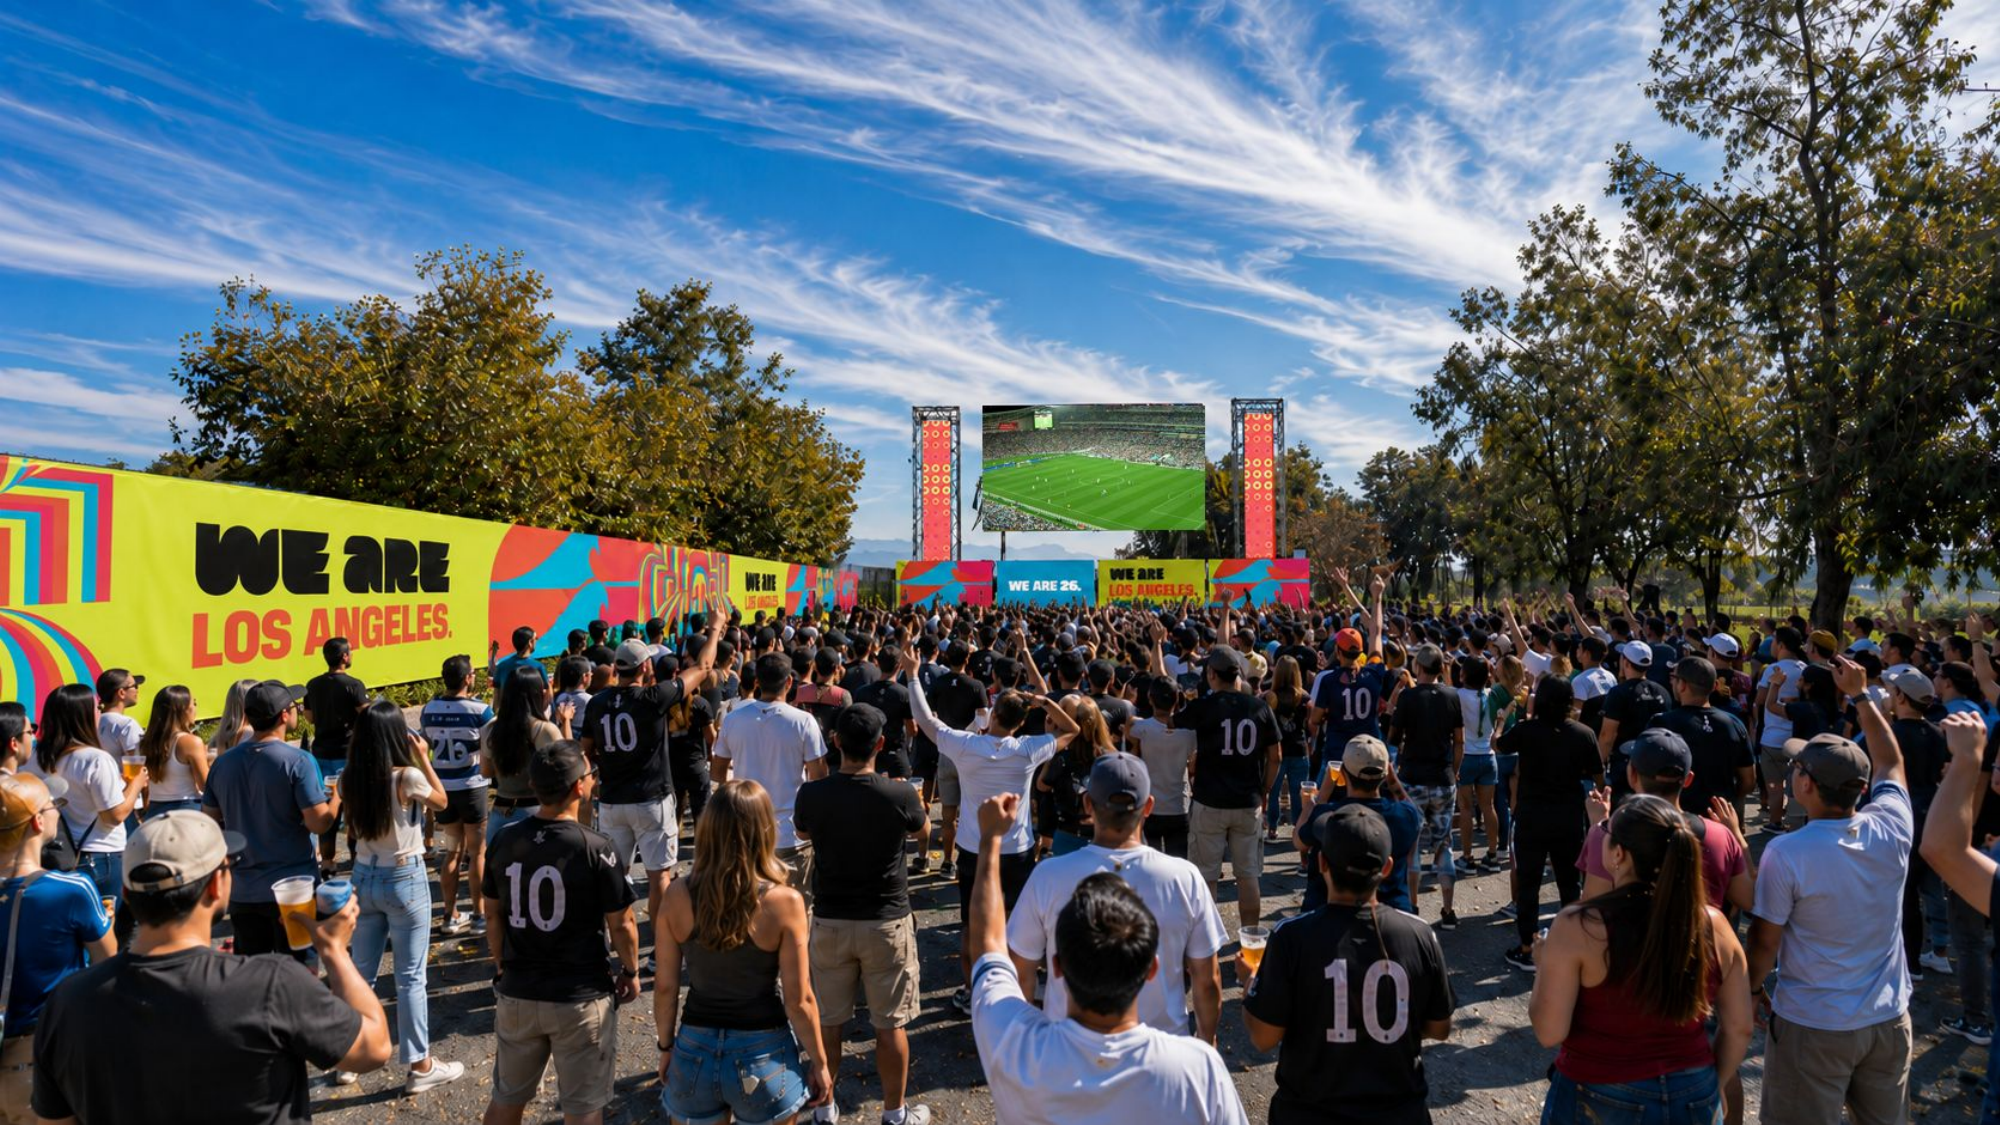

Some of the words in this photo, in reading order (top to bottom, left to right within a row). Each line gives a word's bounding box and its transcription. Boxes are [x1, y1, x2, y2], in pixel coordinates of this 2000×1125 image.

[195, 522, 330, 596] WE
[1110, 568, 1134, 580] WE
[1008, 580, 1030, 591] WE
[1032, 580, 1058, 591] ARE
[1060, 580, 1082, 591] 26.
[1109, 584, 1133, 597] LOS
[192, 609, 292, 669] LOS
[303, 603, 452, 656] ANGELES.
[1341, 687, 1372, 720] 10
[600, 712, 638, 752] 10
[1220, 718, 1257, 756] 10
[505, 862, 566, 932] 10
[1324, 958, 1410, 1044] 10
